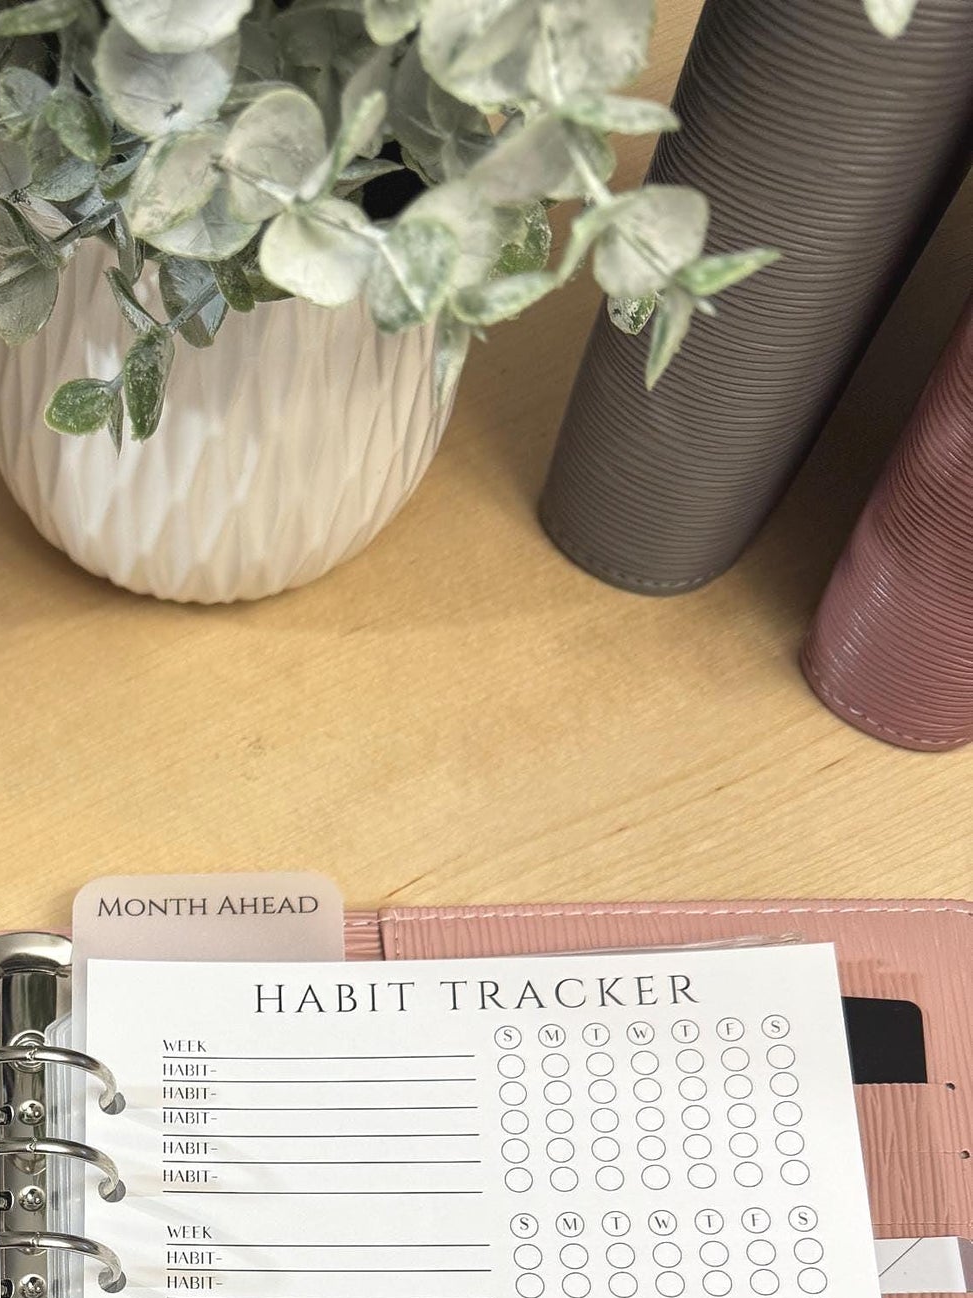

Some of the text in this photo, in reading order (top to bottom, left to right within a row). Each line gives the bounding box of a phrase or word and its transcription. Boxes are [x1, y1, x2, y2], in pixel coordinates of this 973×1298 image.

[97, 895, 319, 918] MONTH AHEAD
[253, 974, 700, 1014] HABIT TRACKER
[162, 1039, 207, 1053] WEEK
[166, 1225, 213, 1240] WEEK
